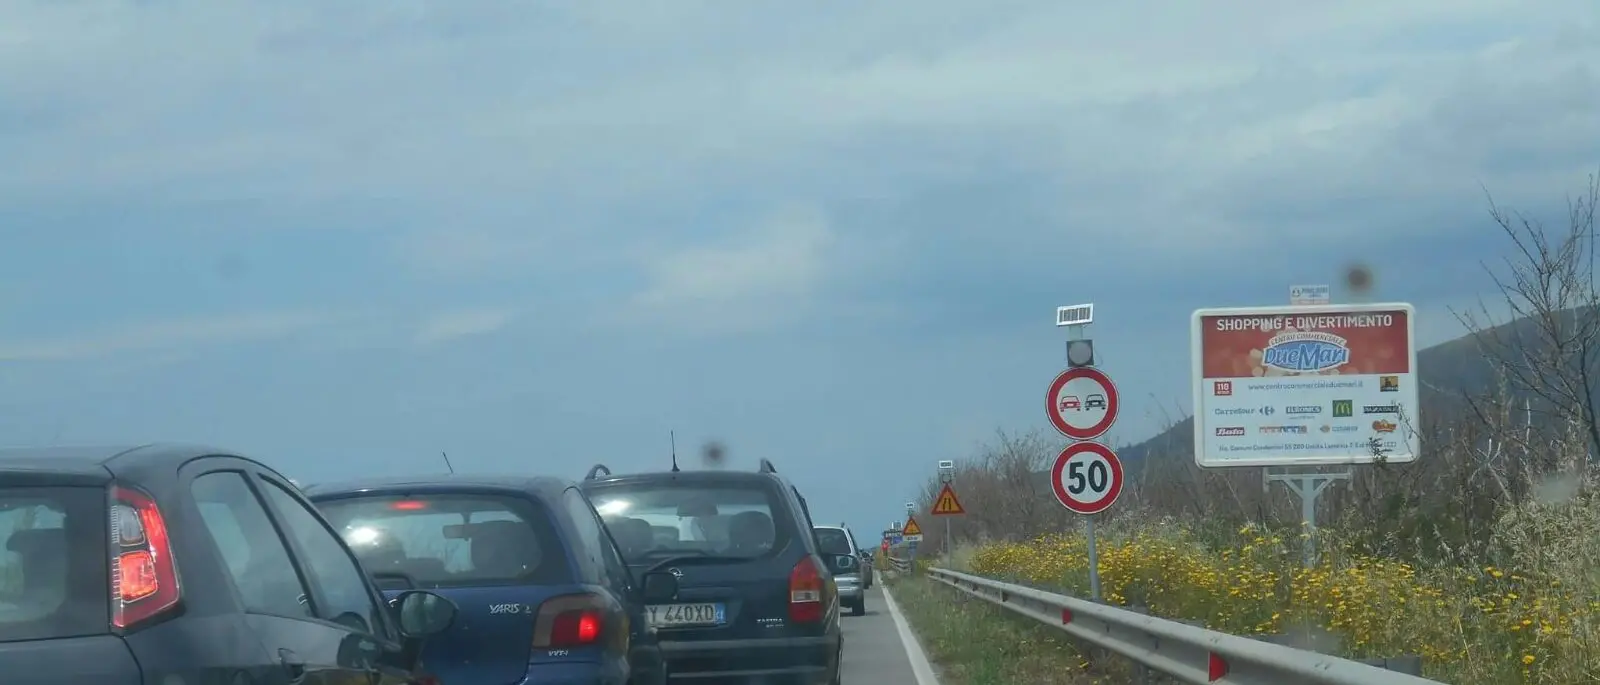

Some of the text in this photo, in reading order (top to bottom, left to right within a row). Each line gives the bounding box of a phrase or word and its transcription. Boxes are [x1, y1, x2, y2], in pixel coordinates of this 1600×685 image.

[1217, 314, 1393, 331] SHOPPING E DIVERTIMENTO
[1214, 407, 1255, 416] Carrefour
[1068, 460, 1108, 495] 50
[489, 603, 520, 614] YARIS
[664, 604, 714, 622] 440XD
